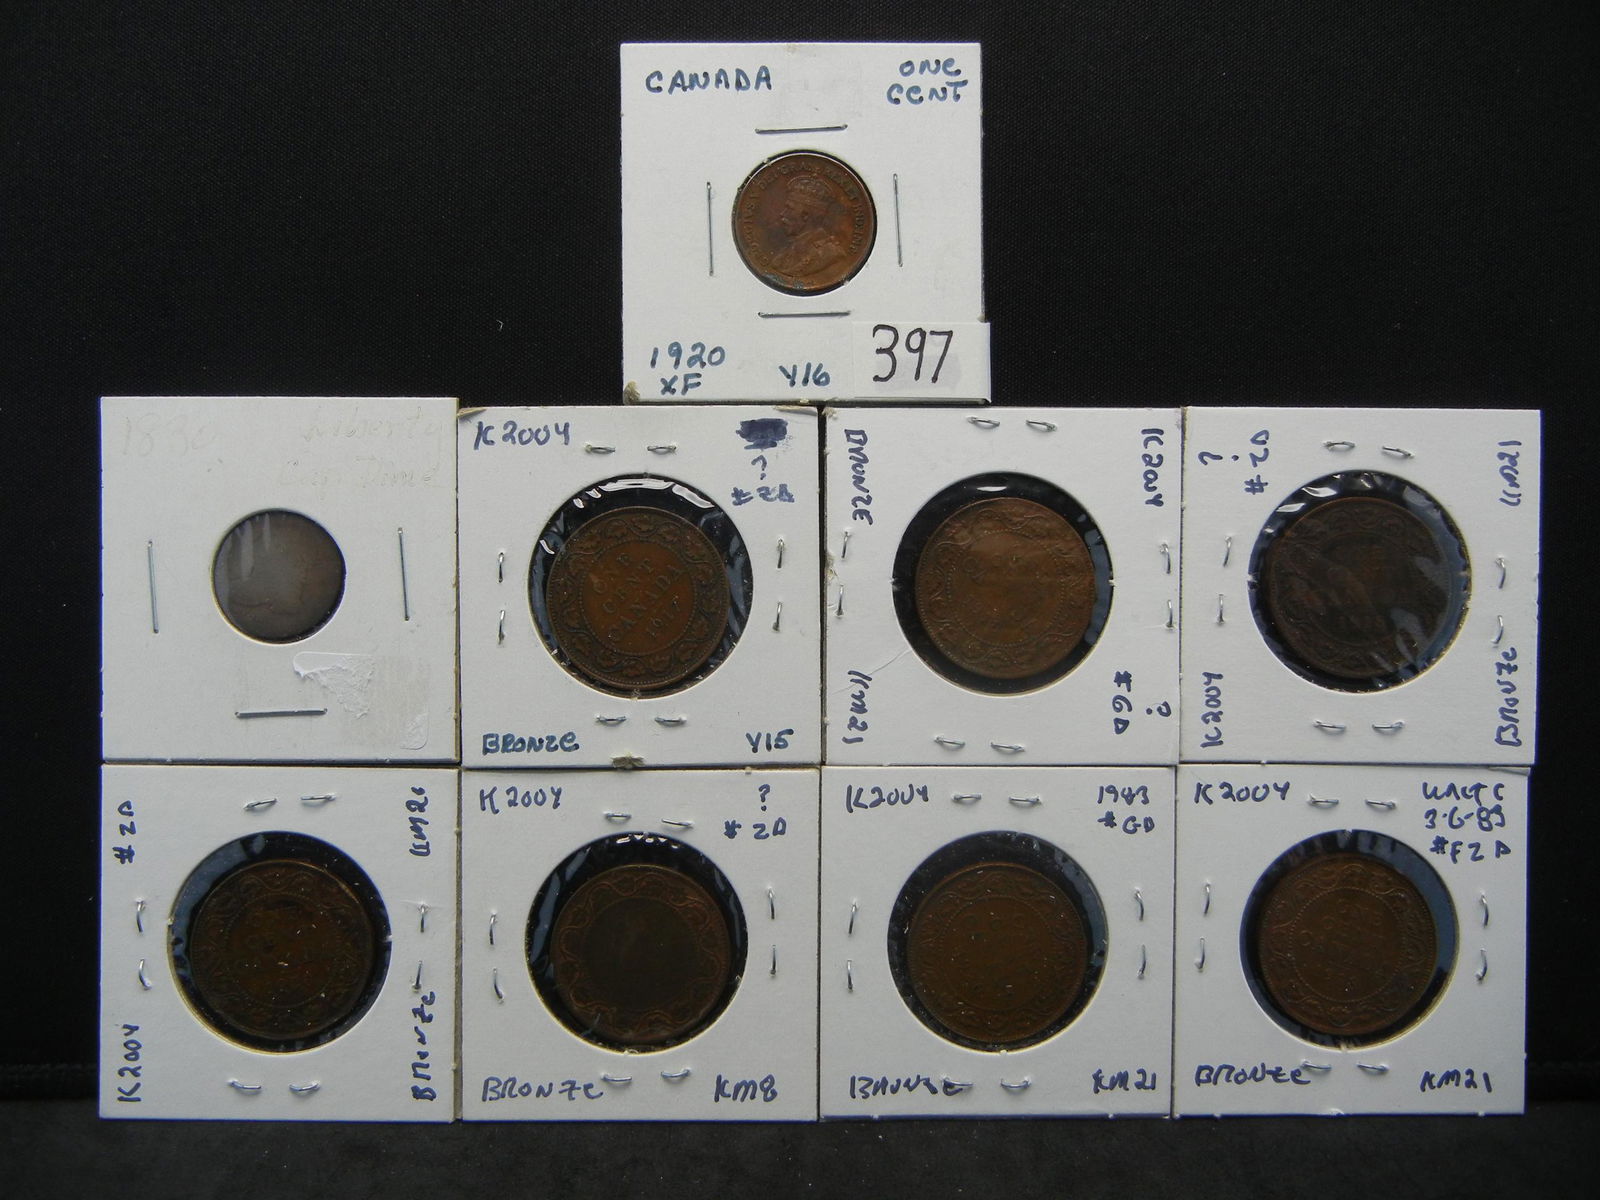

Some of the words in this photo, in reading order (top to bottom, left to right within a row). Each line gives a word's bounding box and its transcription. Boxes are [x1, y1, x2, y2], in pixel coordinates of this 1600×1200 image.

[645, 65, 772, 95] CANADA
[898, 57, 962, 78] ONE
[886, 79, 969, 106] CENT
[649, 341, 726, 370] 1920
[872, 323, 954, 385] 397
